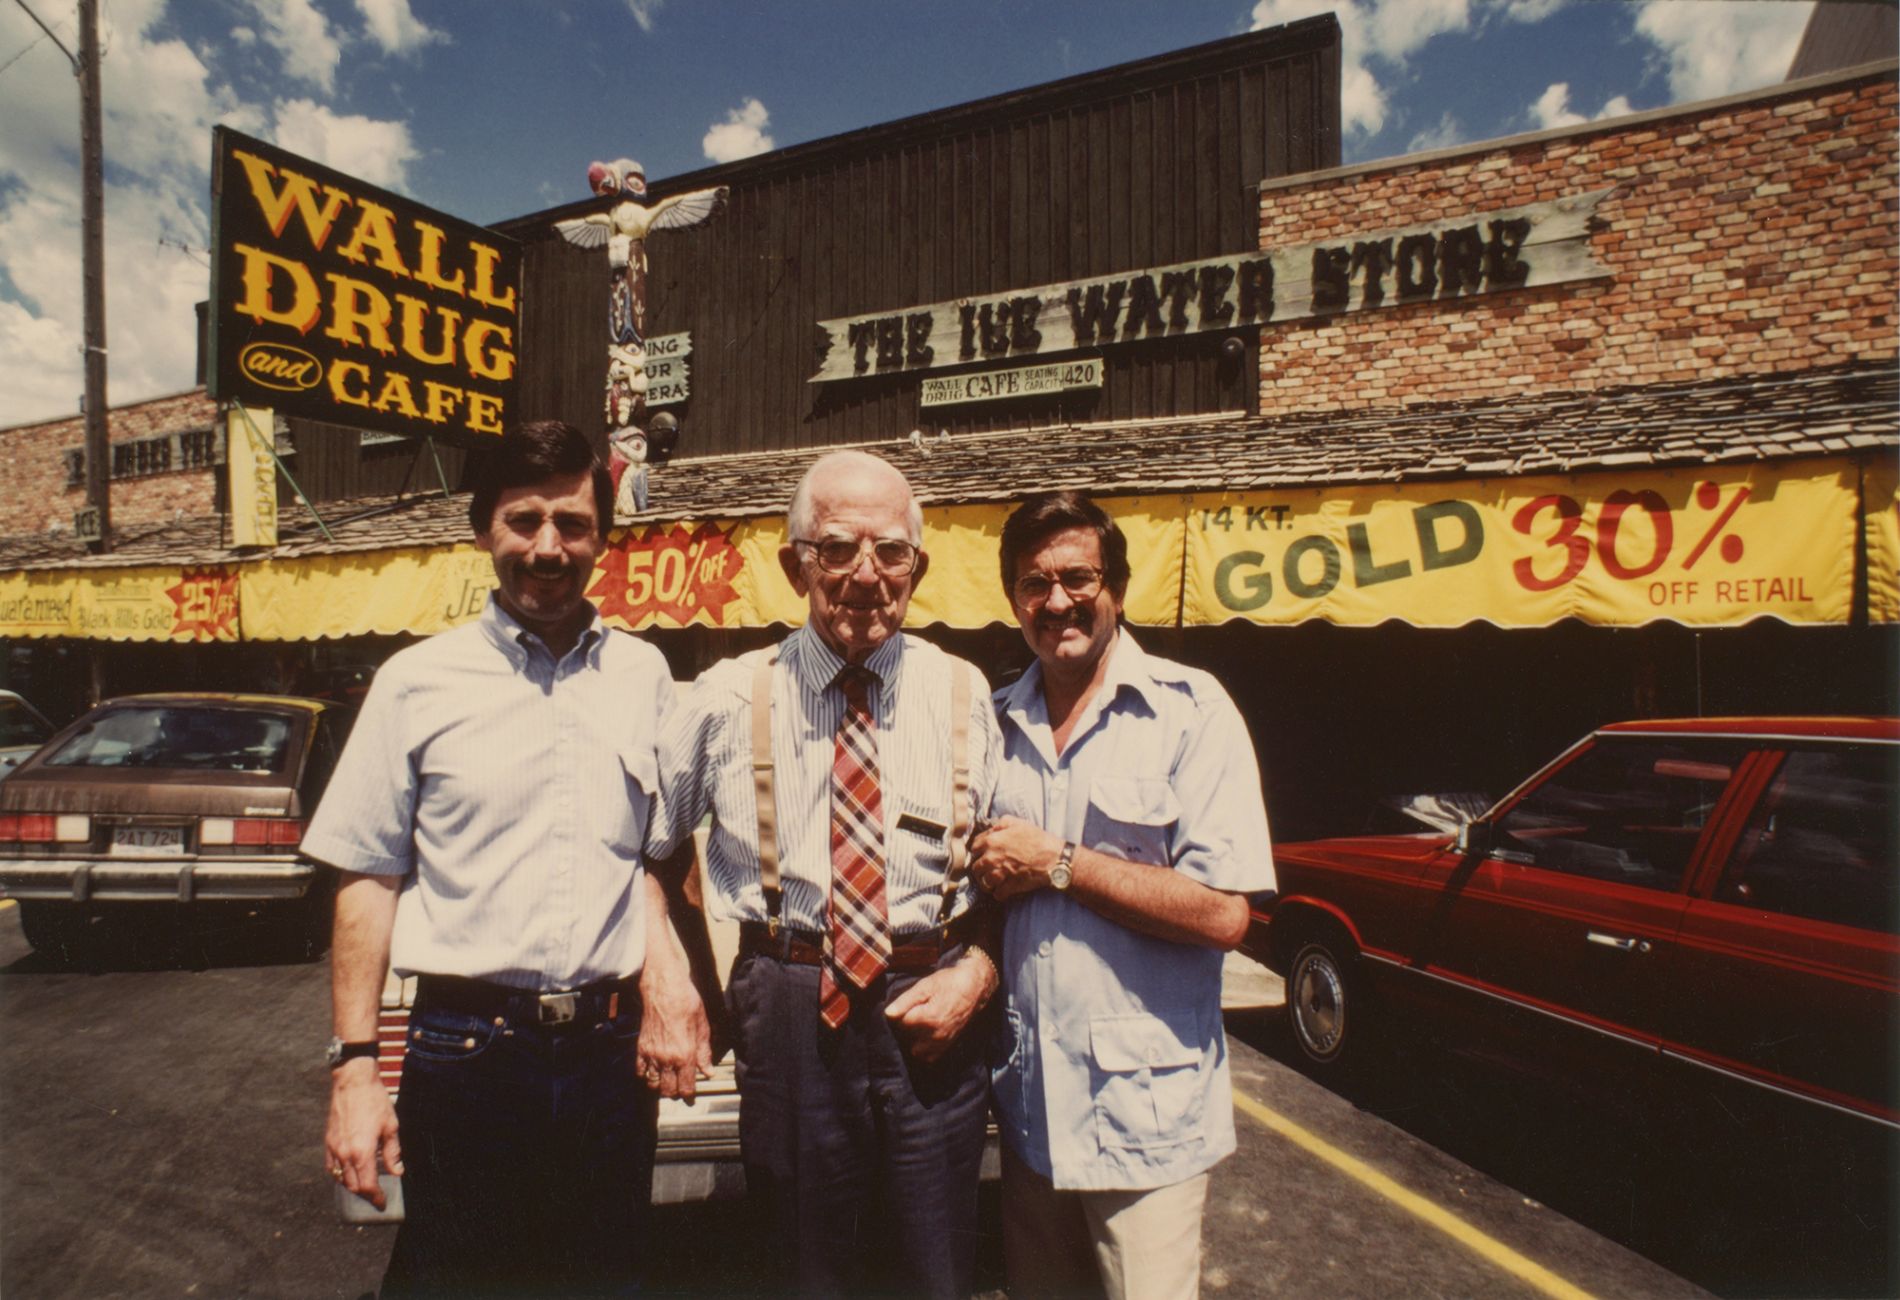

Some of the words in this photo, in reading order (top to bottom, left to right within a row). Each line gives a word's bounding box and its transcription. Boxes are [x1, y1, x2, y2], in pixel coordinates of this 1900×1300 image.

[233, 150, 516, 314] WALL
[849, 311, 934, 376] THE
[958, 296, 1043, 361] ICE
[1066, 257, 1276, 349] WATER
[1310, 218, 1531, 313] STORE
[234, 243, 516, 382] DRUG
[644, 338, 679, 357] ING
[247, 349, 318, 387] and
[645, 363, 671, 379] UR
[1024, 368, 1059, 380] SEATING
[1064, 364, 1095, 386] 420
[327, 358, 504, 436] CAFE
[648, 384, 684, 400] ERA
[925, 390, 963, 404] DRUG
[926, 379, 962, 392] WALL
[966, 371, 1020, 399] CAFE
[1024, 379, 1064, 392] CAPACITY
[1202, 506, 1234, 532] 14
[1245, 504, 1294, 532] KT.
[1512, 480, 1752, 592] 30%
[1213, 499, 1485, 613] GOLD
[625, 540, 707, 607] 50%
[1648, 581, 1700, 607] OFF
[1716, 576, 1815, 603] RETAIL
